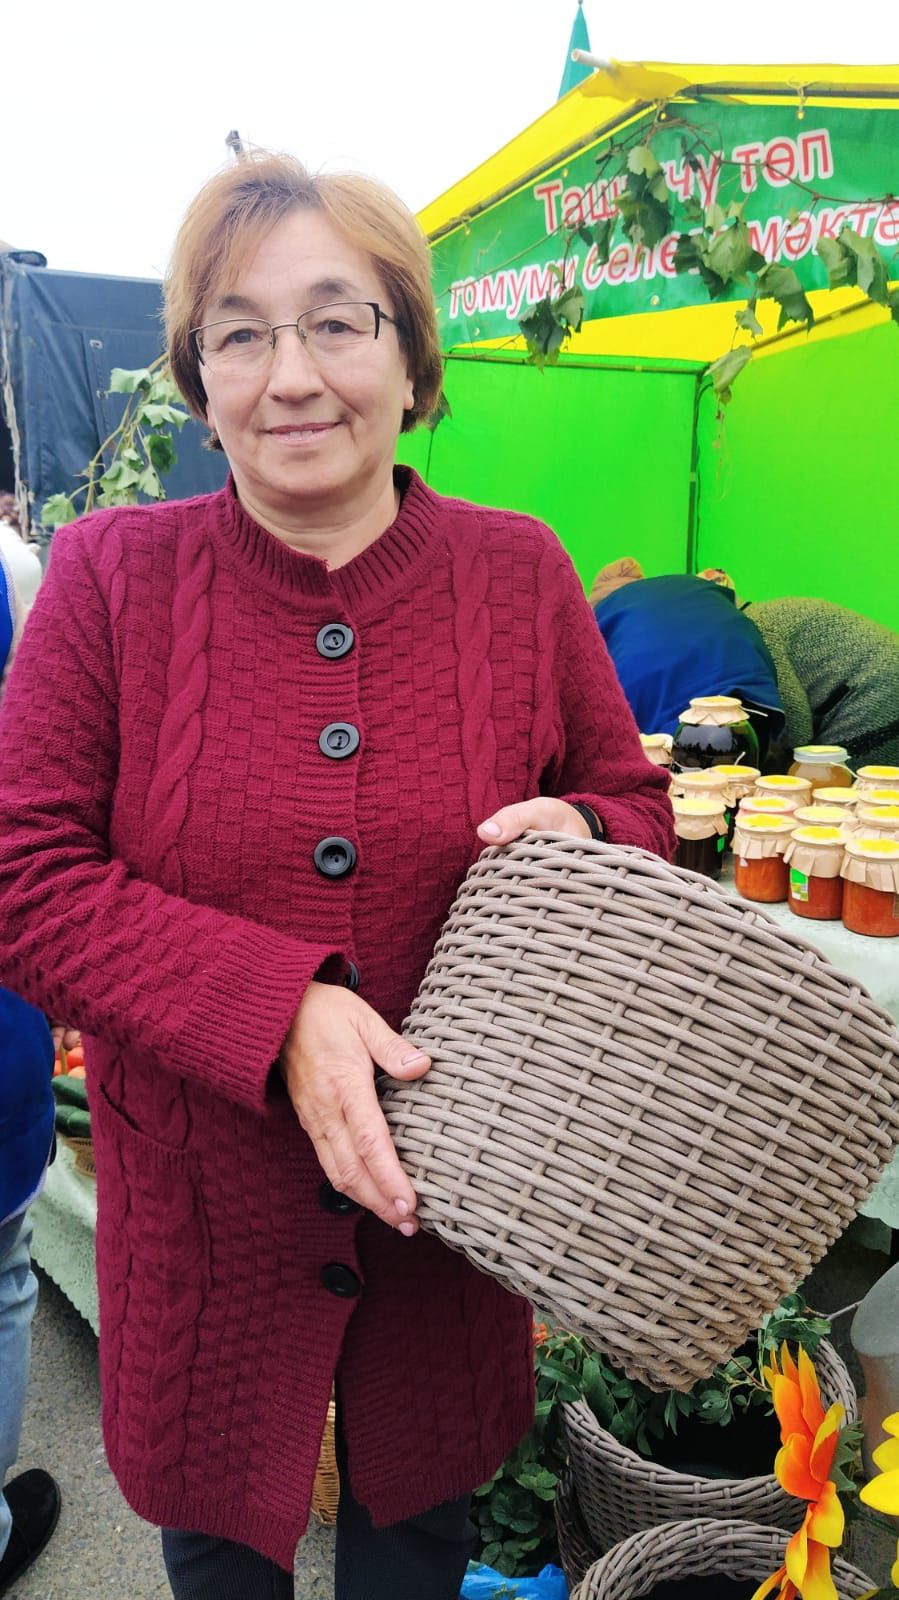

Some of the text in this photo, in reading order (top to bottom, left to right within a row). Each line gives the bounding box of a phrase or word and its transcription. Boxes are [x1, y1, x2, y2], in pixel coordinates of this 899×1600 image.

[534, 132, 831, 232] Ташчү төп
[585, 230, 722, 289] беле
